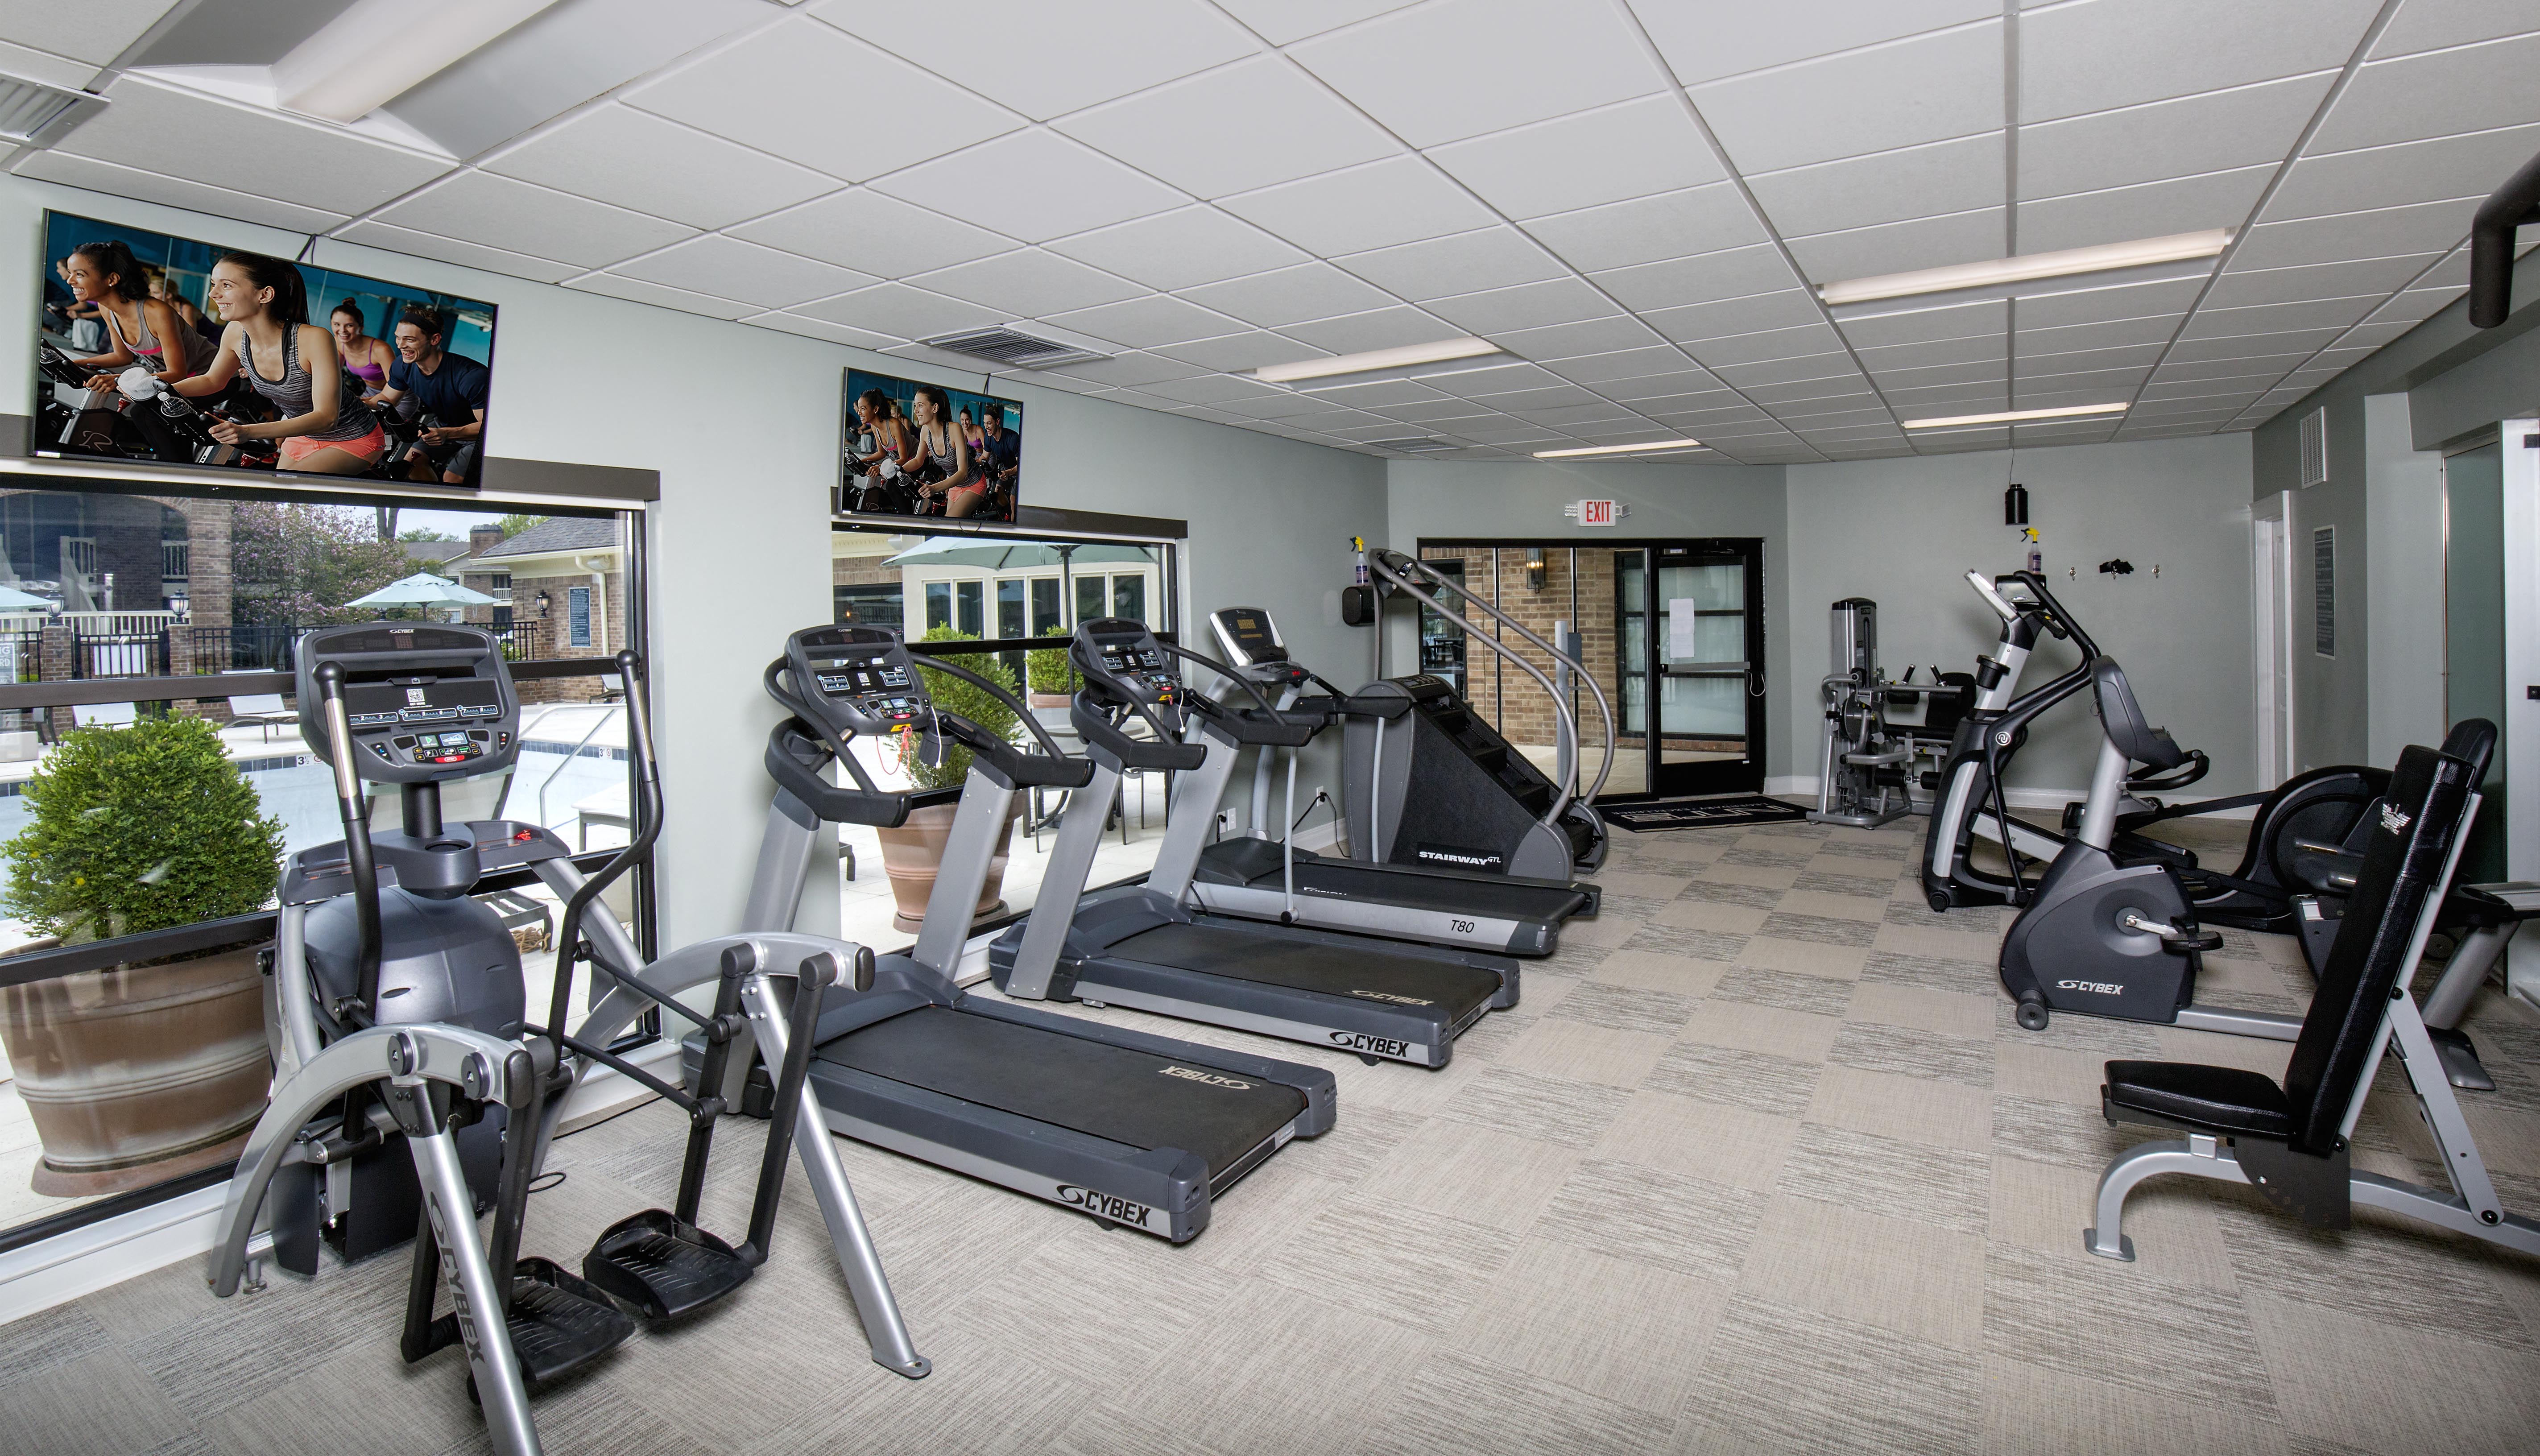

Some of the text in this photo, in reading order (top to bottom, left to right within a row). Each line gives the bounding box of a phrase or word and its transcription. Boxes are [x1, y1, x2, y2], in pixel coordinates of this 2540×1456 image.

[1586, 501, 1611, 522] EXIT
[1419, 851, 1488, 865] STAIRWAY
[1451, 919, 1475, 933] T80
[2078, 981, 2124, 995] CYBEX
[1372, 993, 1435, 1006] CYBEX
[1353, 1034, 1410, 1058] CYBEX
[1158, 1066, 1228, 1085] CYBEX
[1085, 1190, 1151, 1227] CYBEX
[440, 1247, 486, 1364] CYBEX
